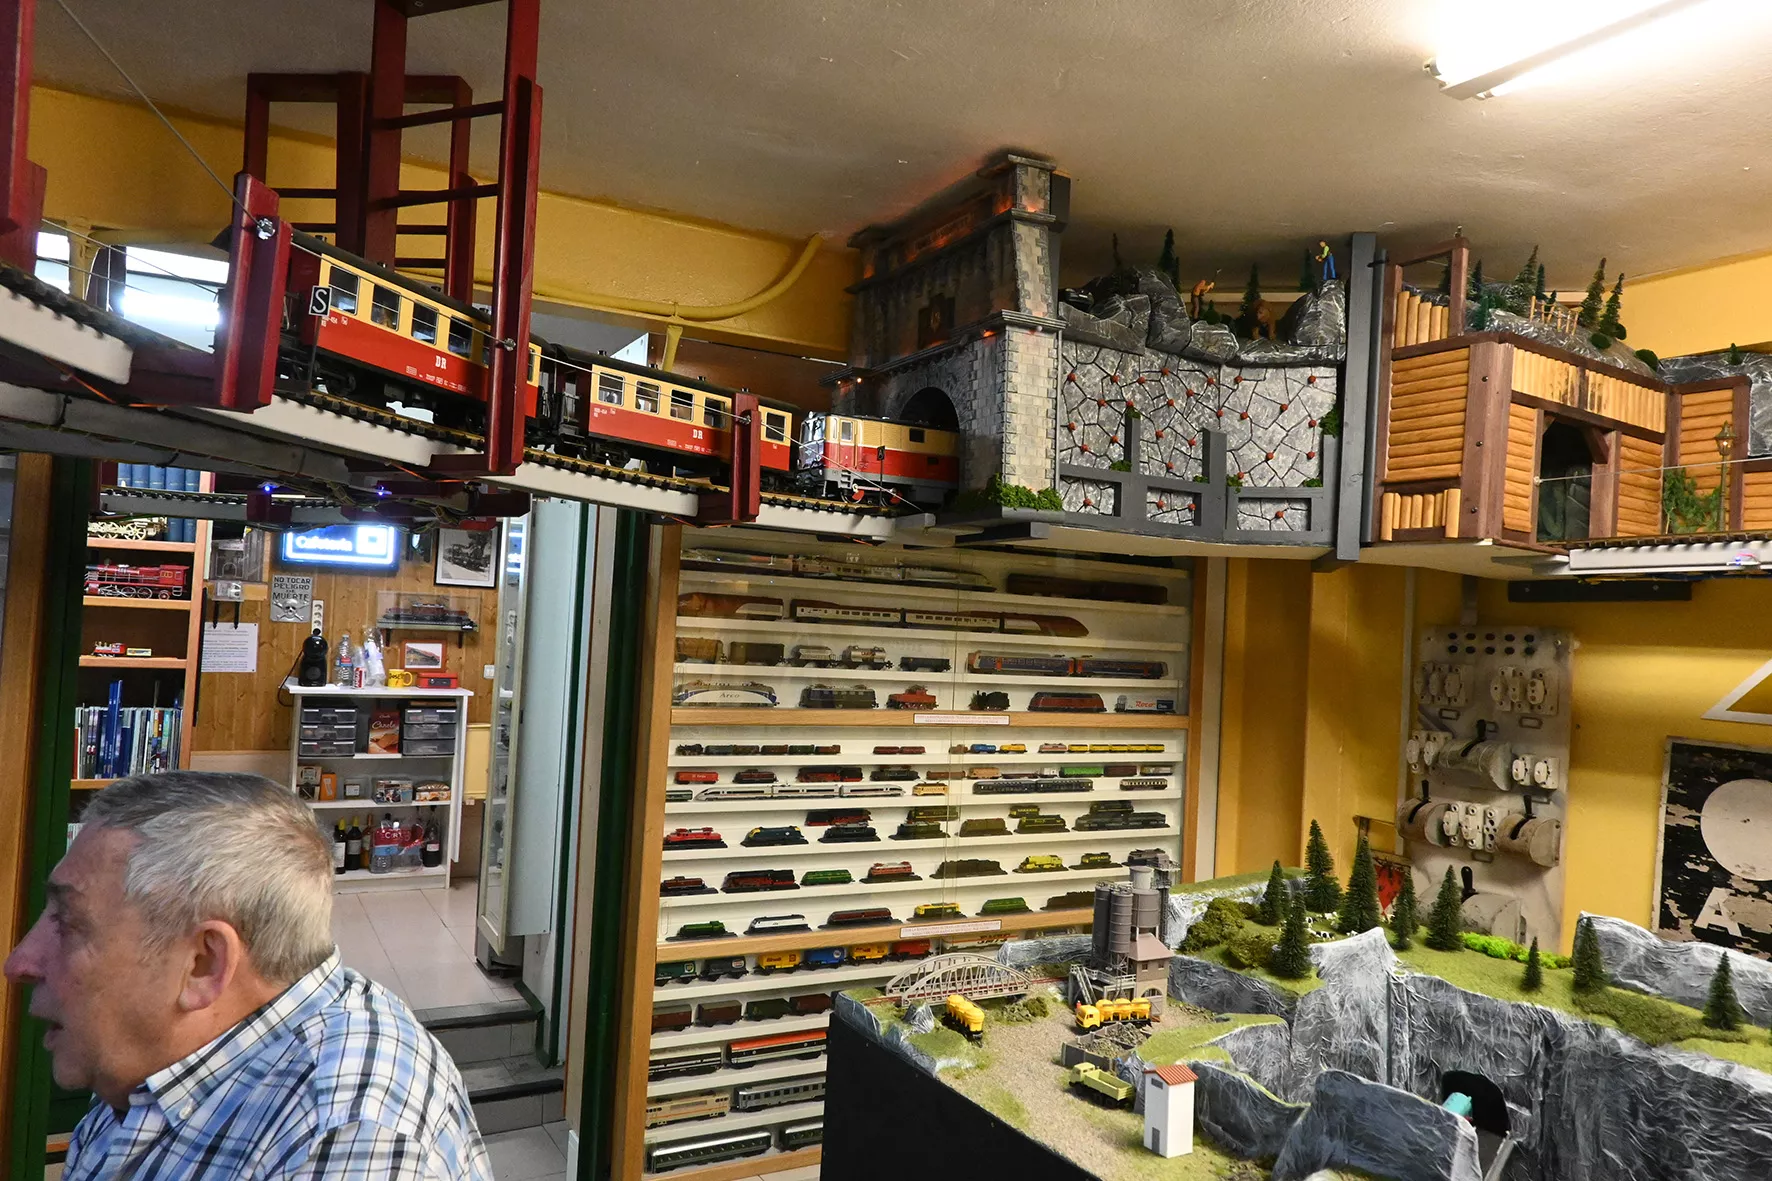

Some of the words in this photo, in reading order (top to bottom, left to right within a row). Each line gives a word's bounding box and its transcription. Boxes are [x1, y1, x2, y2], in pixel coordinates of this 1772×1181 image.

[312, 289, 328, 313] S
[435, 355, 447, 370] DR
[692, 429, 703, 440] DR
[273, 582, 310, 590] PELIGRO
[272, 592, 310, 602] MUERTE
